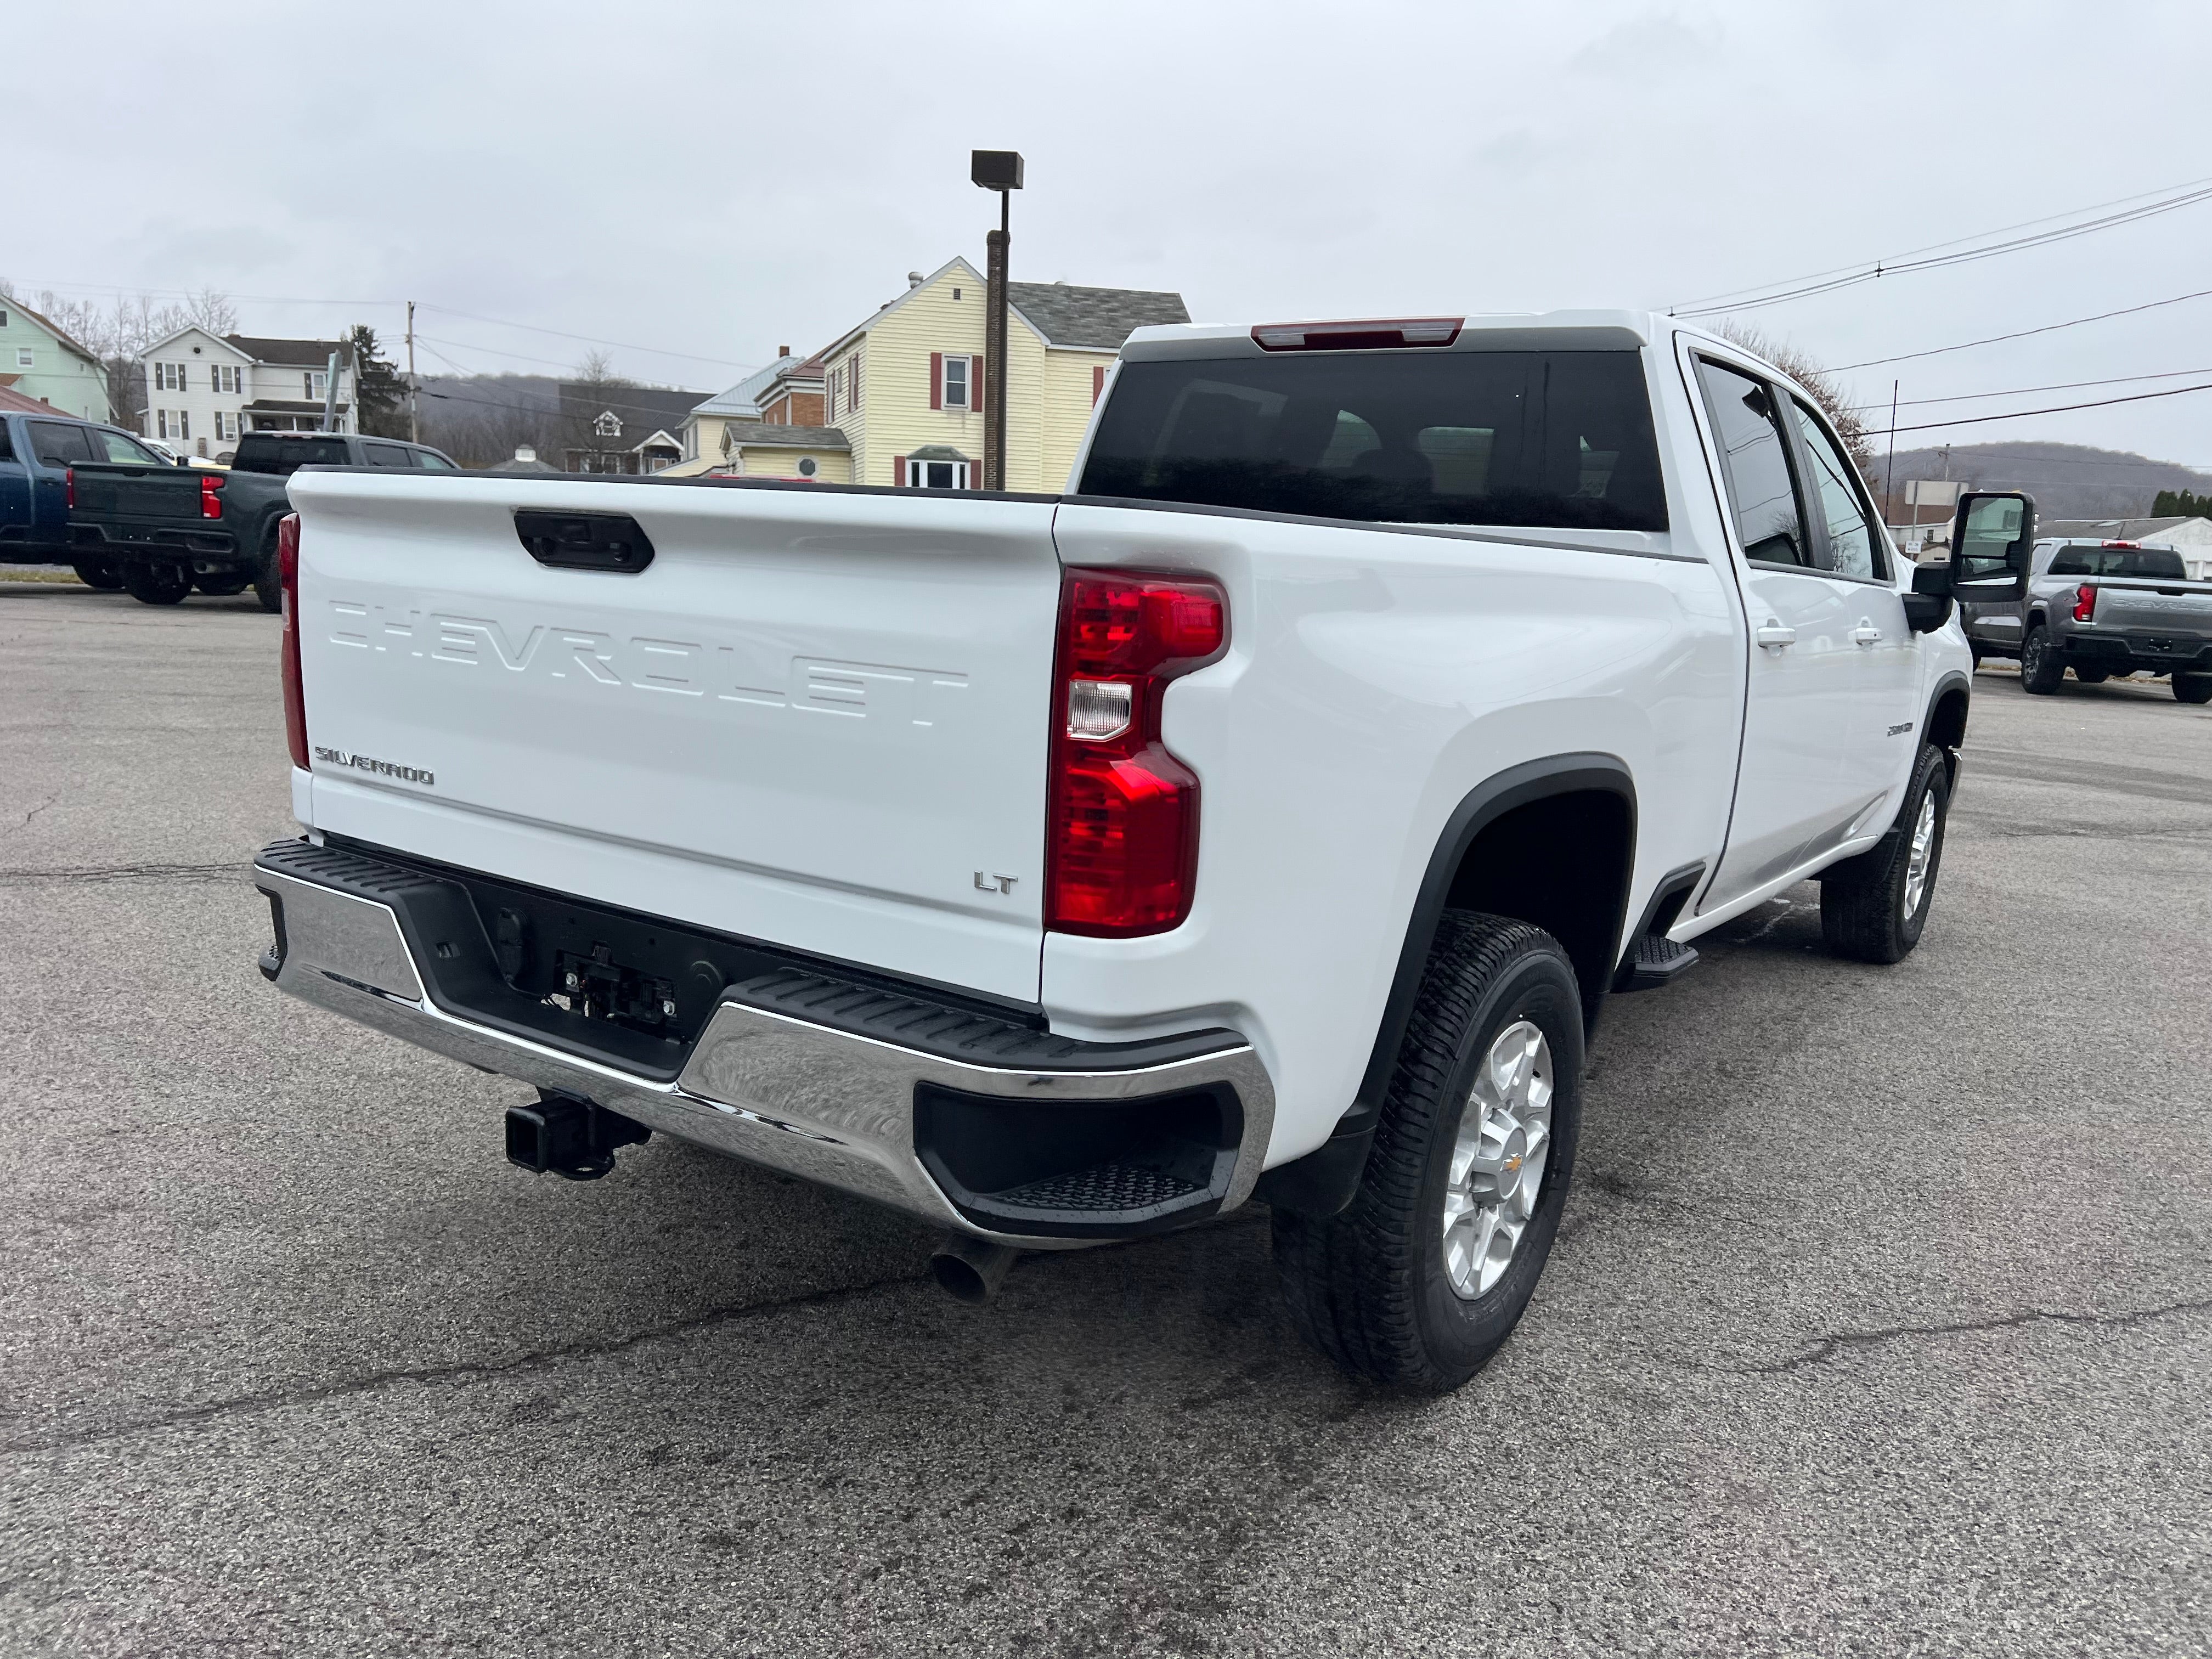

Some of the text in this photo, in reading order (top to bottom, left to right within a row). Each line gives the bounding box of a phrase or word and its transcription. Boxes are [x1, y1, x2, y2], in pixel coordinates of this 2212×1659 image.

[329, 600, 969, 726] CHEVROLET
[315, 746, 434, 785] SILVERADO
[974, 871, 1018, 894] LT
